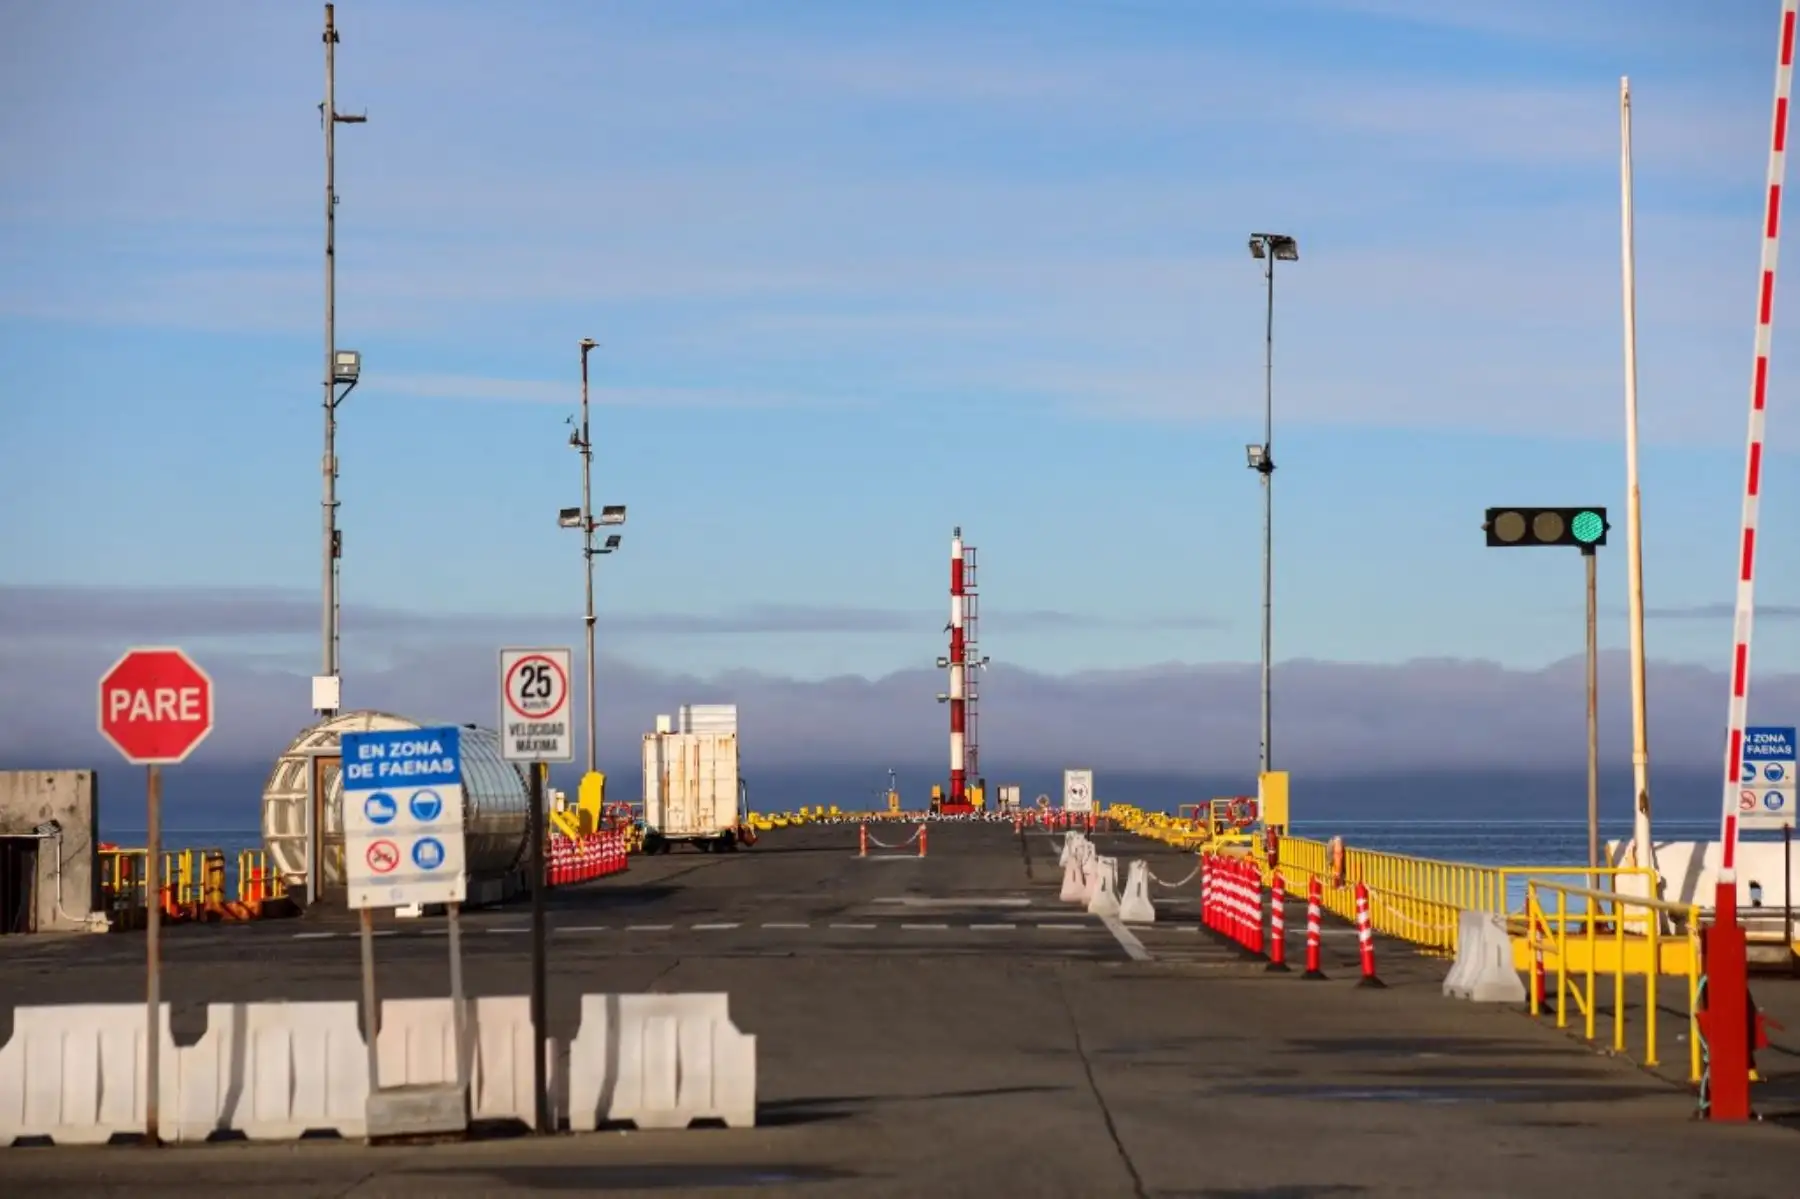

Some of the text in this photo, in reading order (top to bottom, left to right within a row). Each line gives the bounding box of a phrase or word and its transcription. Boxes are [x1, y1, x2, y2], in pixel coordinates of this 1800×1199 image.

[520, 664, 552, 698] 25
[110, 687, 201, 722] PARE
[508, 722, 565, 737] VELOCIDAD
[1753, 734, 1786, 744] ZONA
[358, 739, 443, 760] EN ZONA
[1746, 744, 1793, 755] FAENAS
[348, 757, 455, 779] DE FAENAS
